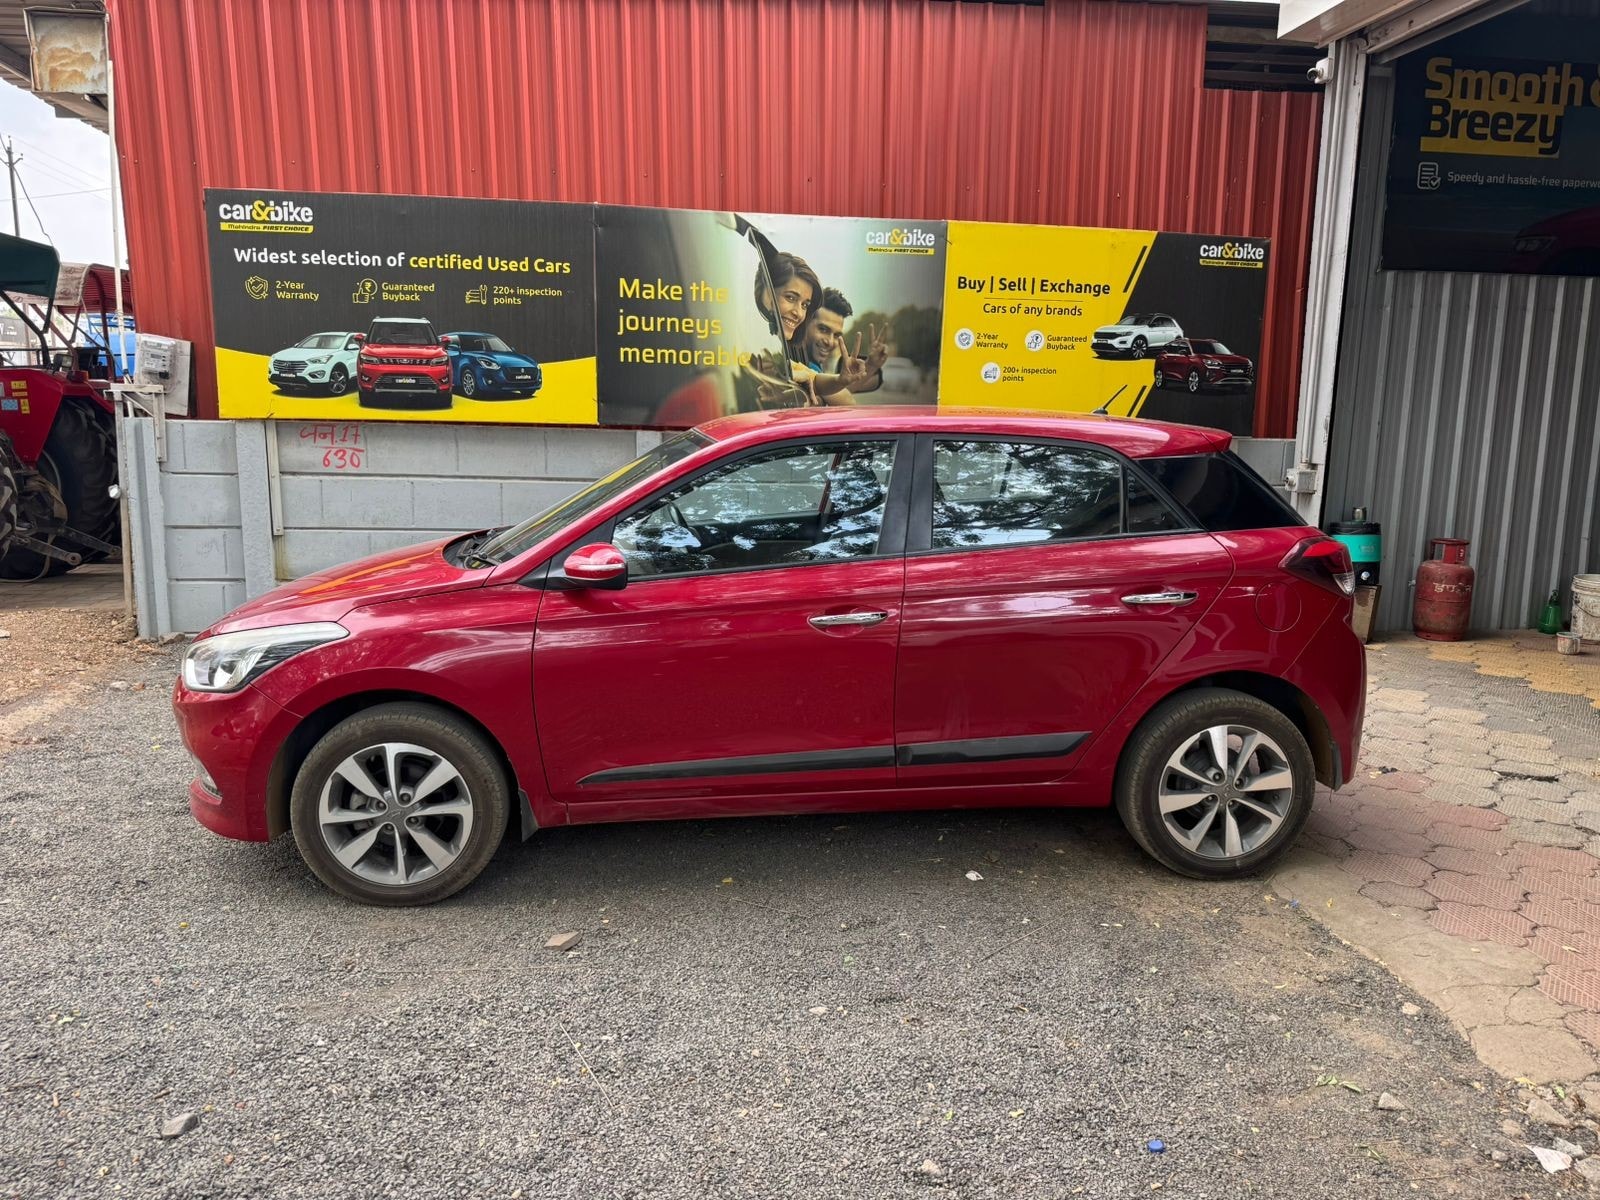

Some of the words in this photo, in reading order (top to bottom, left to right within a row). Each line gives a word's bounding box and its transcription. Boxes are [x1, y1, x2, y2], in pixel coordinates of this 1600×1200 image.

[1425, 57, 1584, 107] Smooth
[1422, 100, 1563, 155] Breezy
[1447, 171, 1484, 185] Speedy
[1486, 174, 1505, 184] and
[1507, 173, 1560, 186] hassle-free
[219, 199, 314, 222] car&bike
[865, 228, 936, 246] car&bike
[1199, 242, 1265, 259] car&bike
[234, 247, 297, 264] Widest
[301, 250, 382, 267] selection
[386, 252, 406, 267] of
[409, 254, 483, 270] certified
[487, 257, 529, 272] Used
[533, 258, 571, 274] Cars
[275, 280, 305, 290] 2-Year
[381, 282, 435, 292] Guaranteed
[493, 286, 515, 295] 220+
[516, 286, 563, 298] inspection
[619, 277, 683, 301] Make
[690, 280, 729, 304] the
[957, 276, 986, 293] Buy
[998, 277, 1027, 292] Sell
[1039, 279, 1111, 297] Exchange
[276, 291, 320, 301] Warranty
[382, 292, 421, 303] Buyback
[493, 296, 522, 305] points
[983, 303, 1007, 314] Cars
[1009, 303, 1022, 314] of
[1024, 306, 1043, 317] any
[1045, 304, 1083, 317] brands
[617, 309, 723, 339] journeys
[976, 332, 999, 341] 2-Year
[1047, 334, 1088, 343] Guaranteed
[976, 341, 1009, 350] Warranty
[1046, 342, 1076, 351] Buyback
[619, 345, 751, 368] memorable
[1002, 366, 1020, 374] 200+
[1021, 366, 1057, 376] inspection
[1002, 374, 1024, 382] points
[322, 449, 361, 469] 630
